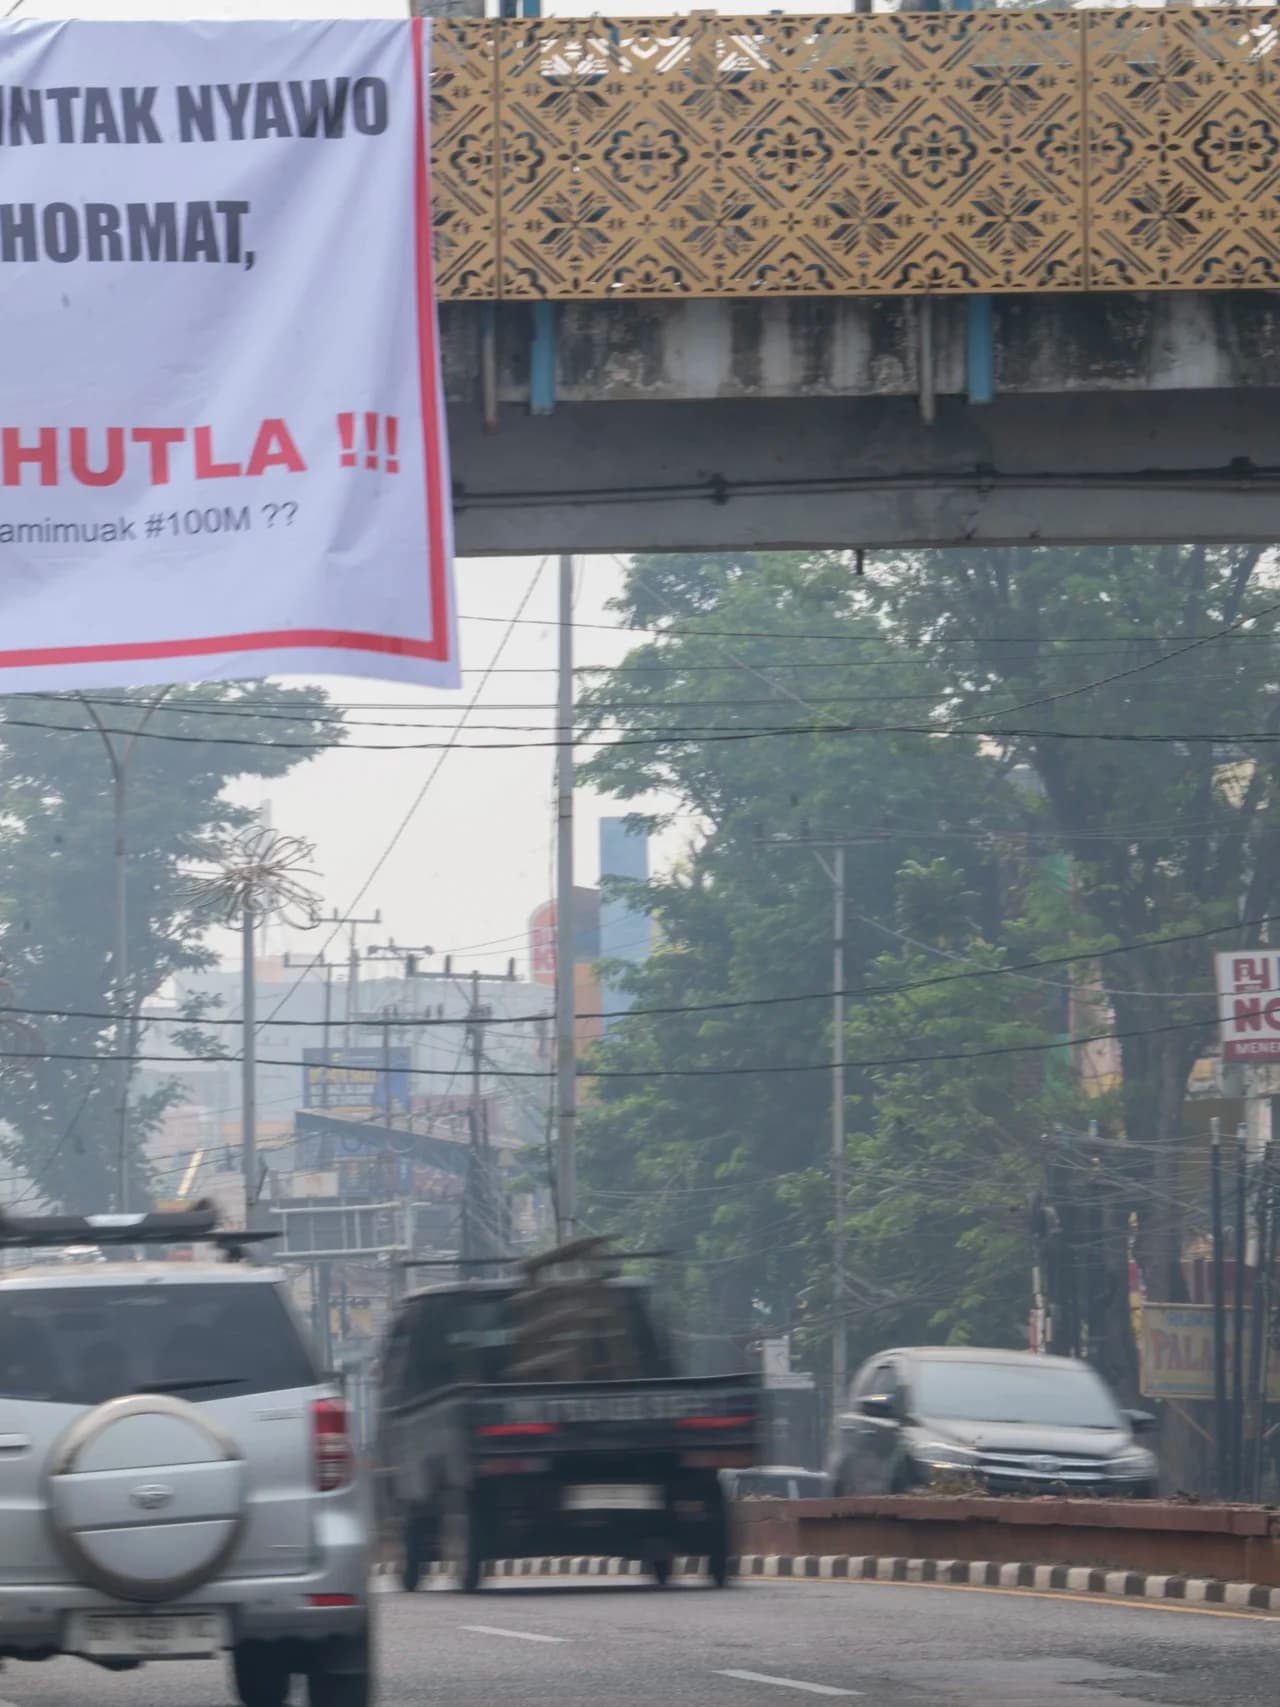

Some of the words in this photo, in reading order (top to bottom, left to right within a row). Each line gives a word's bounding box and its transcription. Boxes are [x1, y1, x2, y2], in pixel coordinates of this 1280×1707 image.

[176, 76, 389, 143] NYAWO
[336, 411, 400, 474] !!!
[144, 506, 251, 536] #100M
[261, 501, 299, 529] ??
